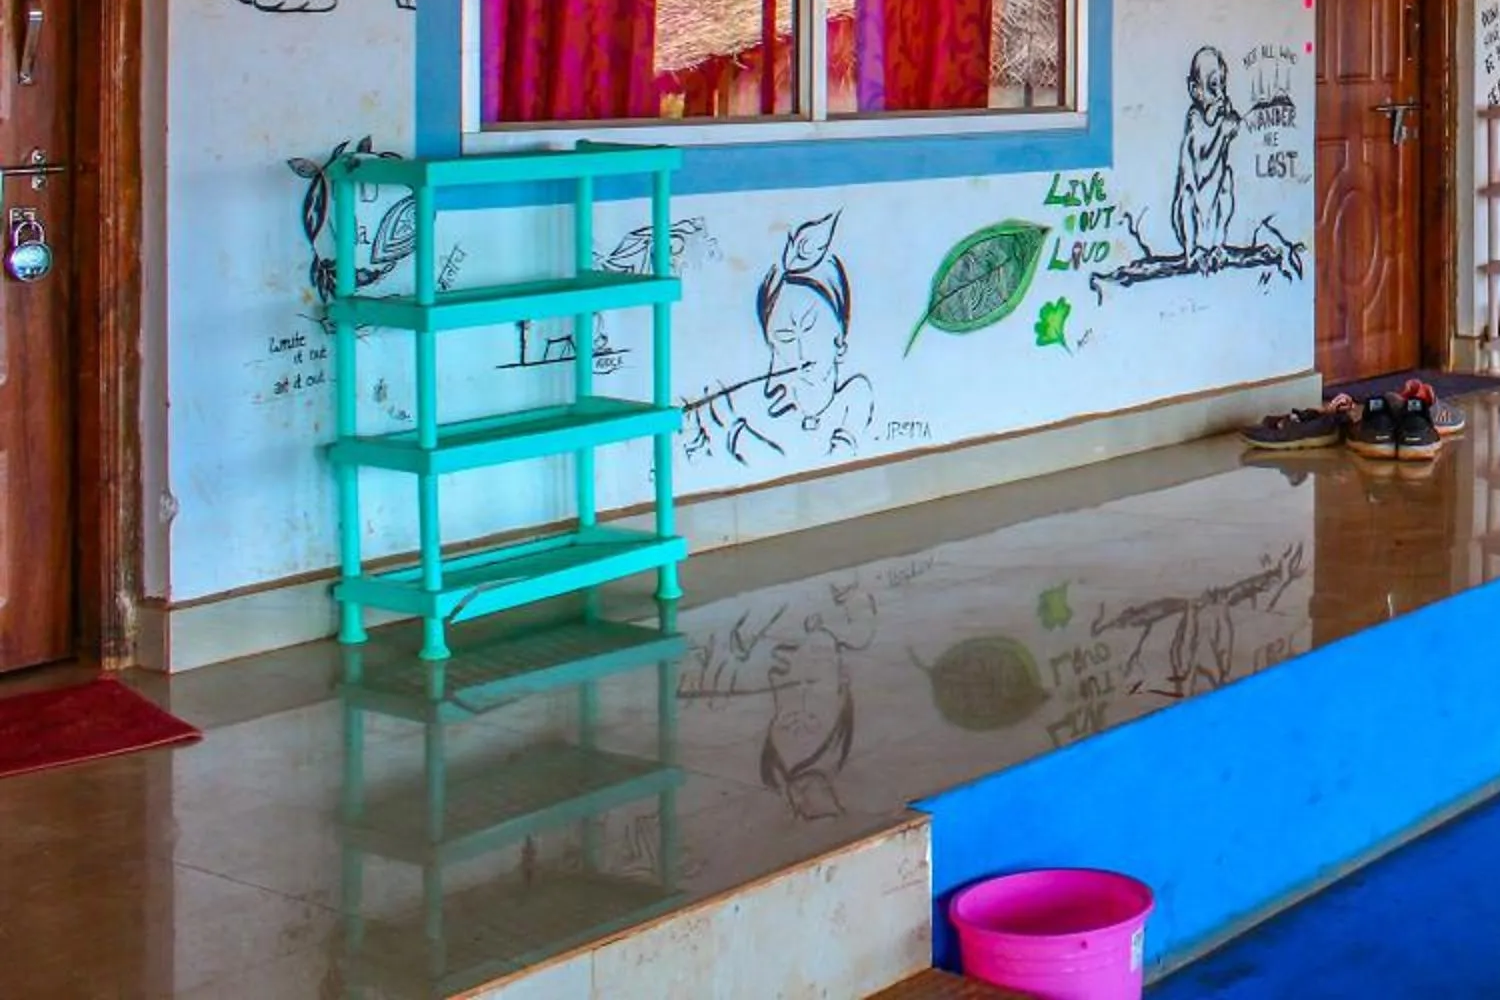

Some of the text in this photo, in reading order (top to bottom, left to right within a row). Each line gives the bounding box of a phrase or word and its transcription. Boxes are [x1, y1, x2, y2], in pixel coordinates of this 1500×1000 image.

[1255, 151, 1299, 178] LOST
[1043, 171, 1107, 207] LIVE
[1079, 206, 1116, 233] OUT
[1047, 236, 1111, 271] LOUD
